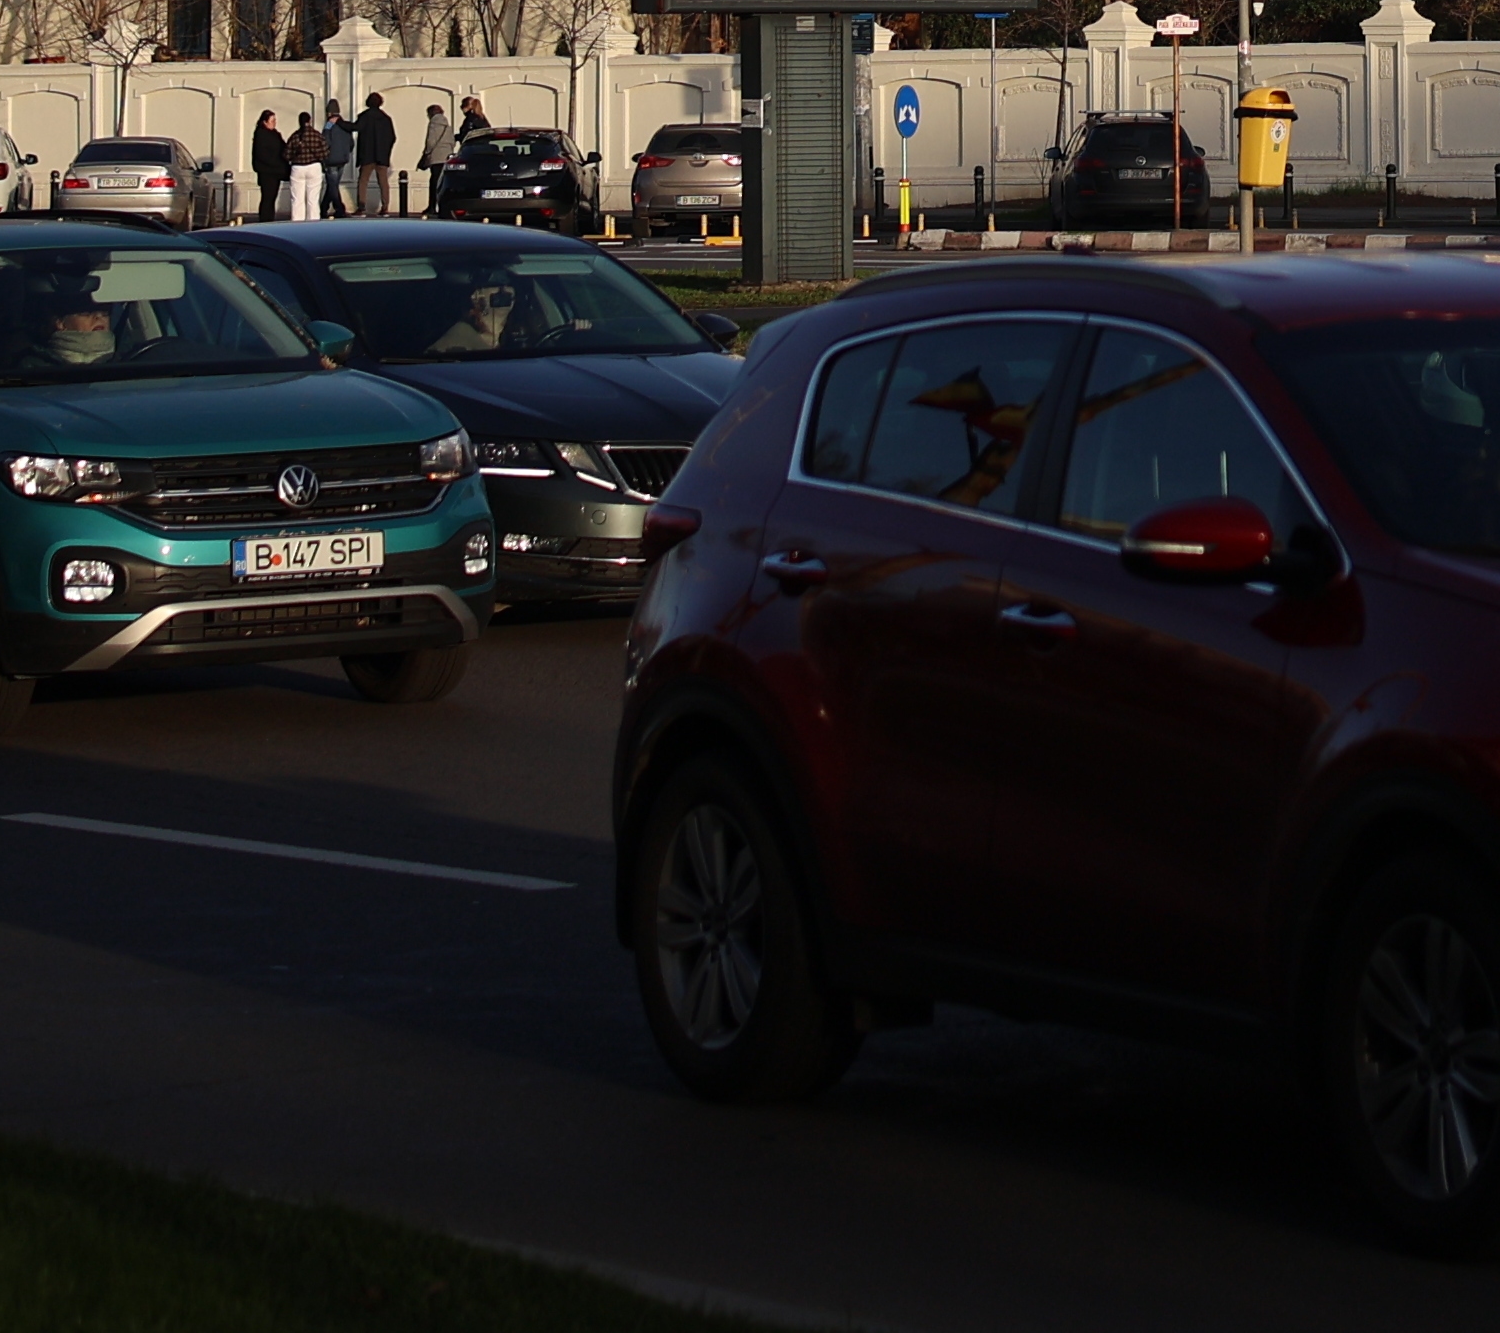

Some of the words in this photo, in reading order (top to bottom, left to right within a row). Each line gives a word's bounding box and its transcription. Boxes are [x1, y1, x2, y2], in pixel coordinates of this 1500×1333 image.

[256, 543, 273, 570] B
[283, 540, 321, 569] 147
[330, 536, 371, 565] SPI
